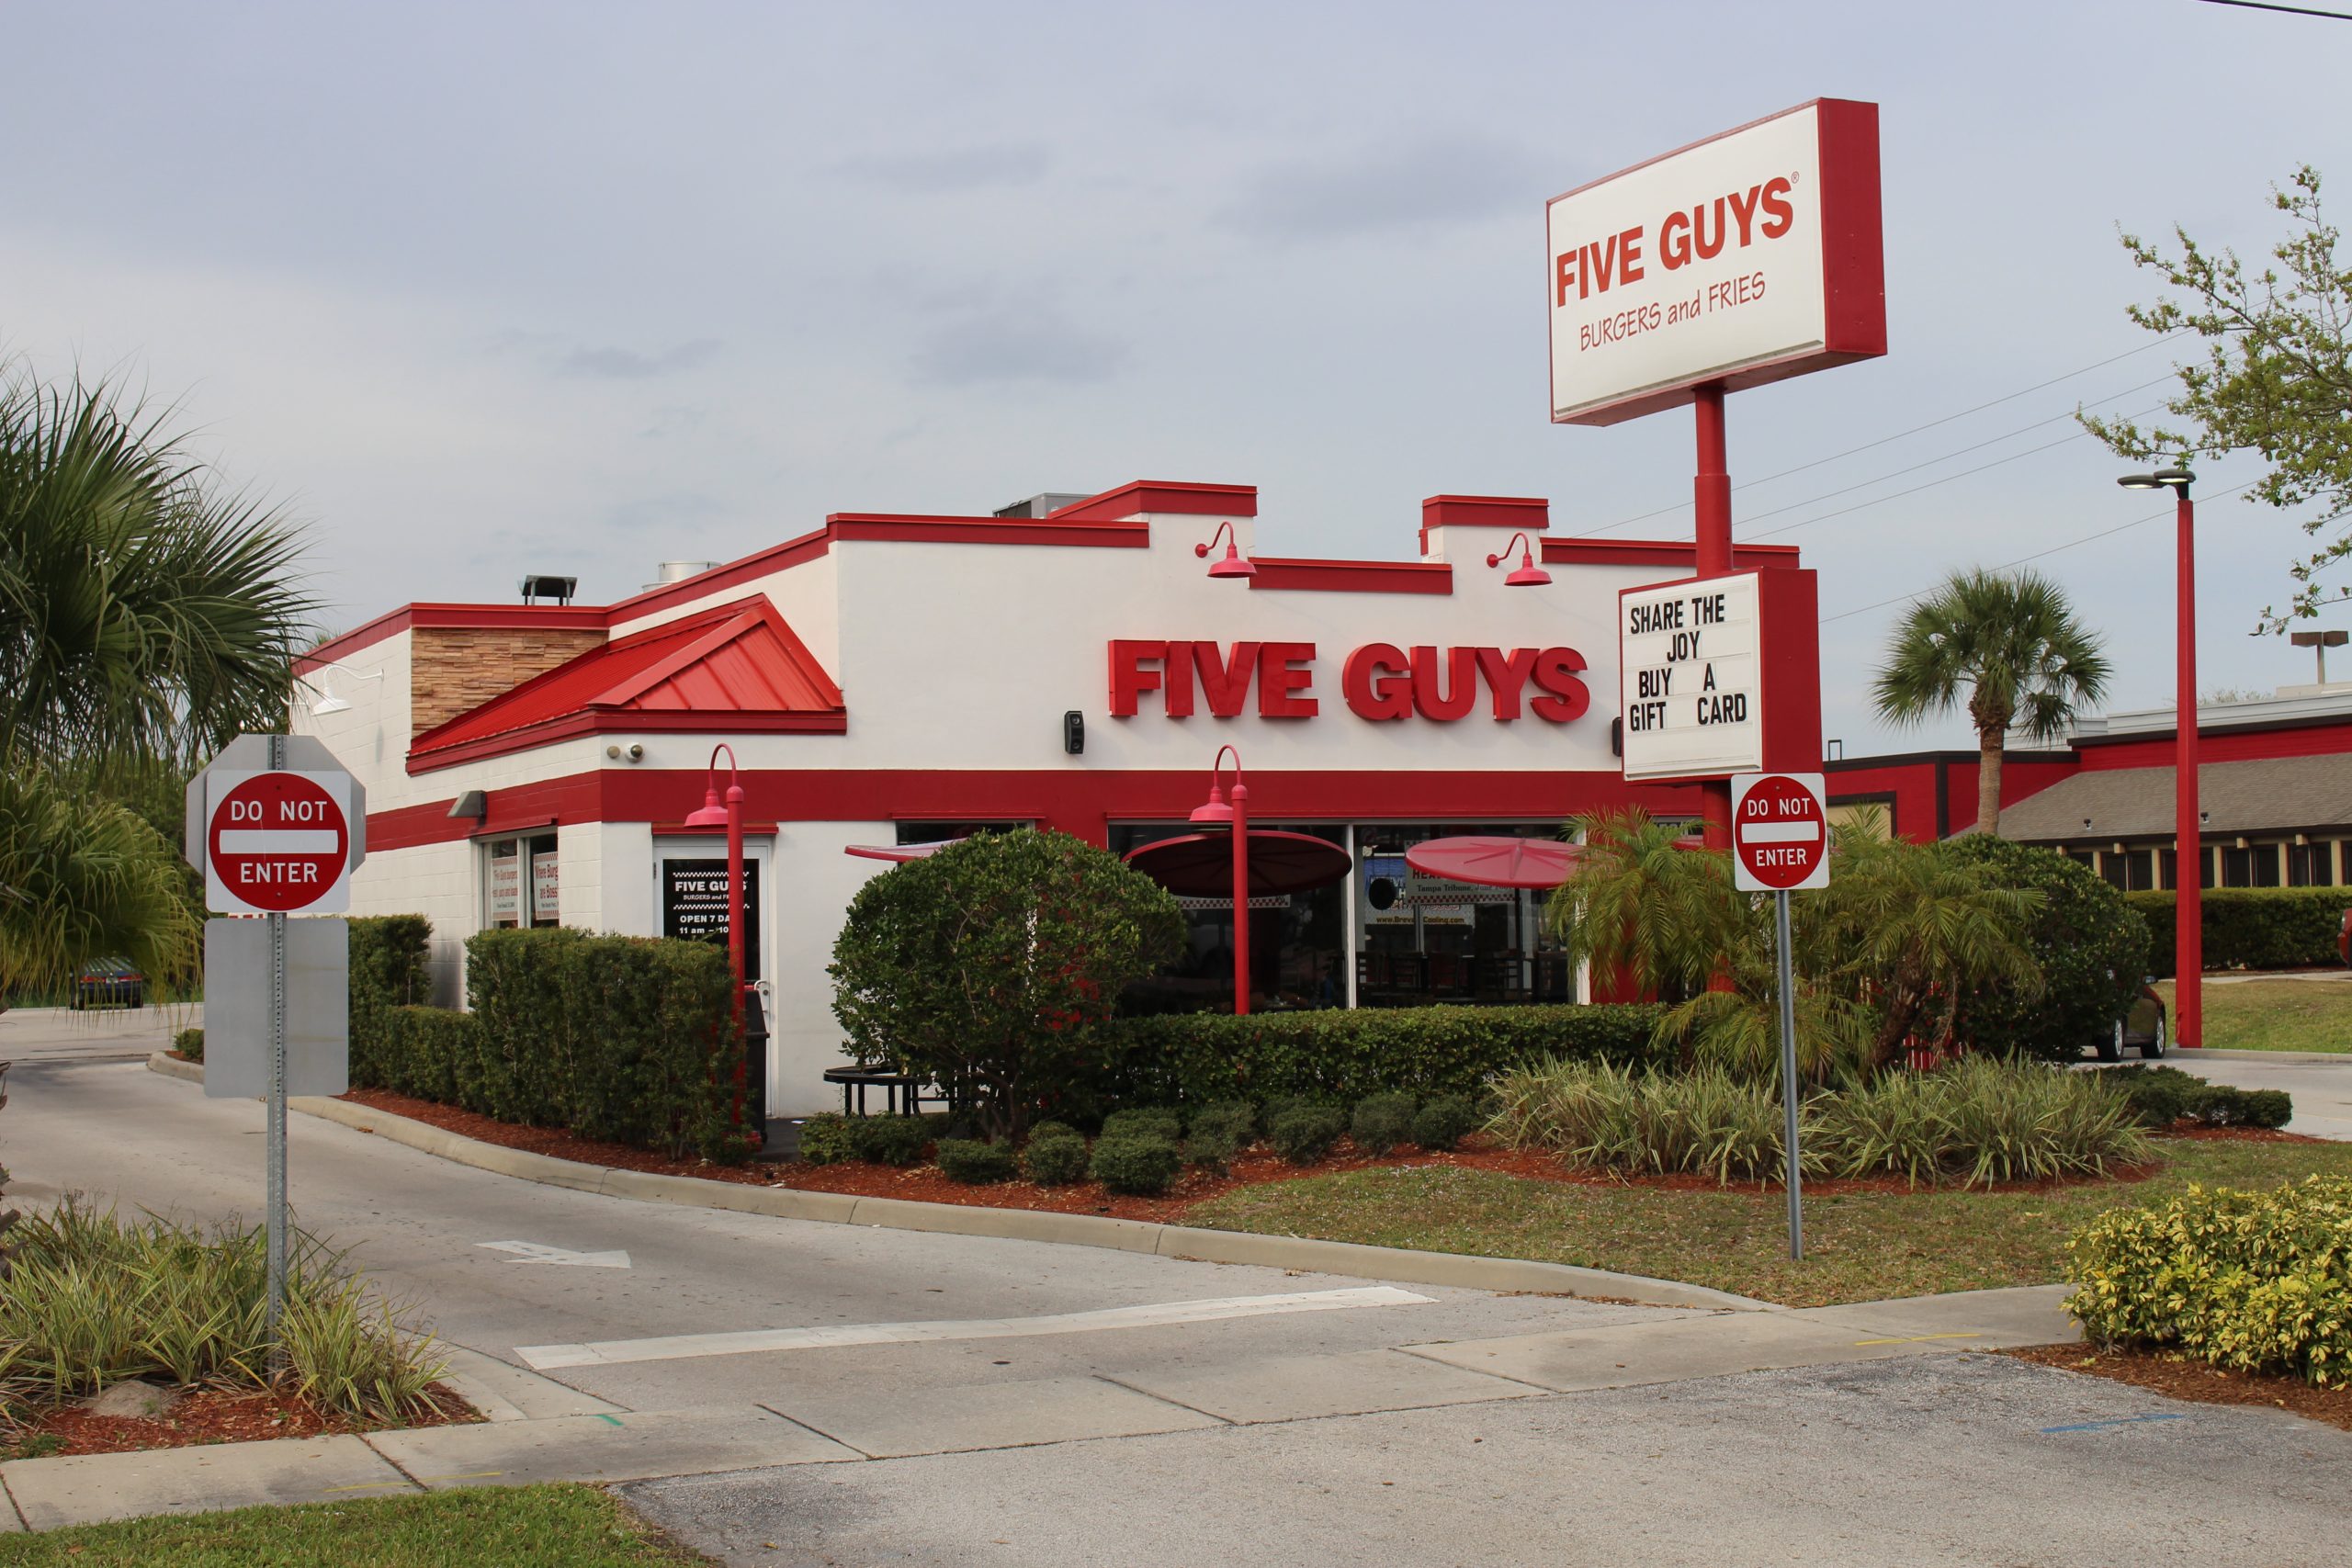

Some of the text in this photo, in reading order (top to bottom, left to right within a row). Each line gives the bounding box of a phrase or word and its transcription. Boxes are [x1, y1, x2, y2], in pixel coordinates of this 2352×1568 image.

[1556, 225, 1645, 308] FIVE
[1580, 271, 1766, 352] BURGERS and FRIES
[1630, 593, 1724, 635] SHARE THE
[1667, 630, 1701, 662] JOY
[1108, 640, 1590, 722] FIVE GUYS
[1638, 662, 1716, 698] BUY A
[1630, 693, 1747, 731] GIFT CARD
[231, 800, 327, 821] DO NOT
[1747, 797, 1811, 817] DO NOT
[1756, 848, 1807, 866] ENTER
[240, 863, 318, 883] ENTER
[674, 881, 706, 891] FIVE
[1417, 885, 1442, 893] Tampa
[680, 914, 707, 923] OPEN
